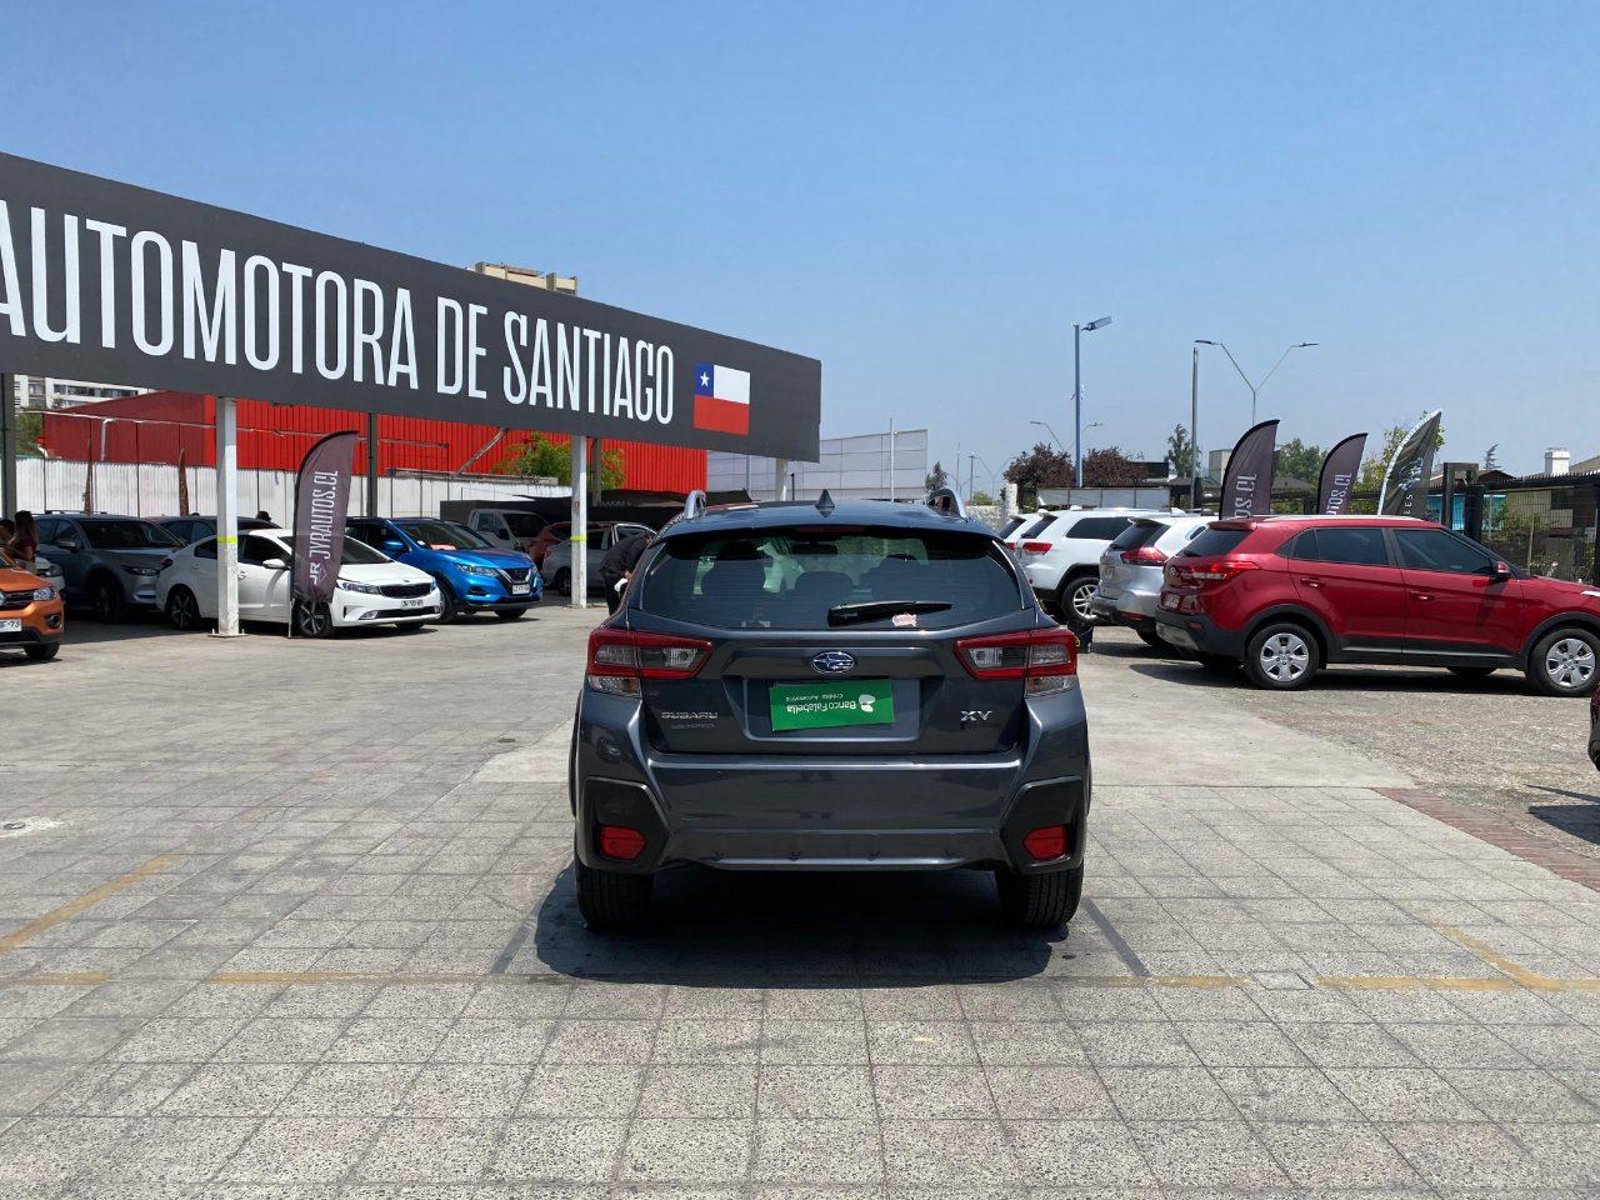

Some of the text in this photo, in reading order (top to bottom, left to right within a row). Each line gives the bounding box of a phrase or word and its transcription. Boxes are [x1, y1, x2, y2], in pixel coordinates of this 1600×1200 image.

[0, 199, 675, 426] AUTOMOTORA DE SANTIAGO
[309, 470, 338, 560] JYRAUTOS.CL
[786, 700, 857, 714] Banco Falabella
[660, 711, 718, 719] SUBARU
[960, 710, 993, 721] XV
